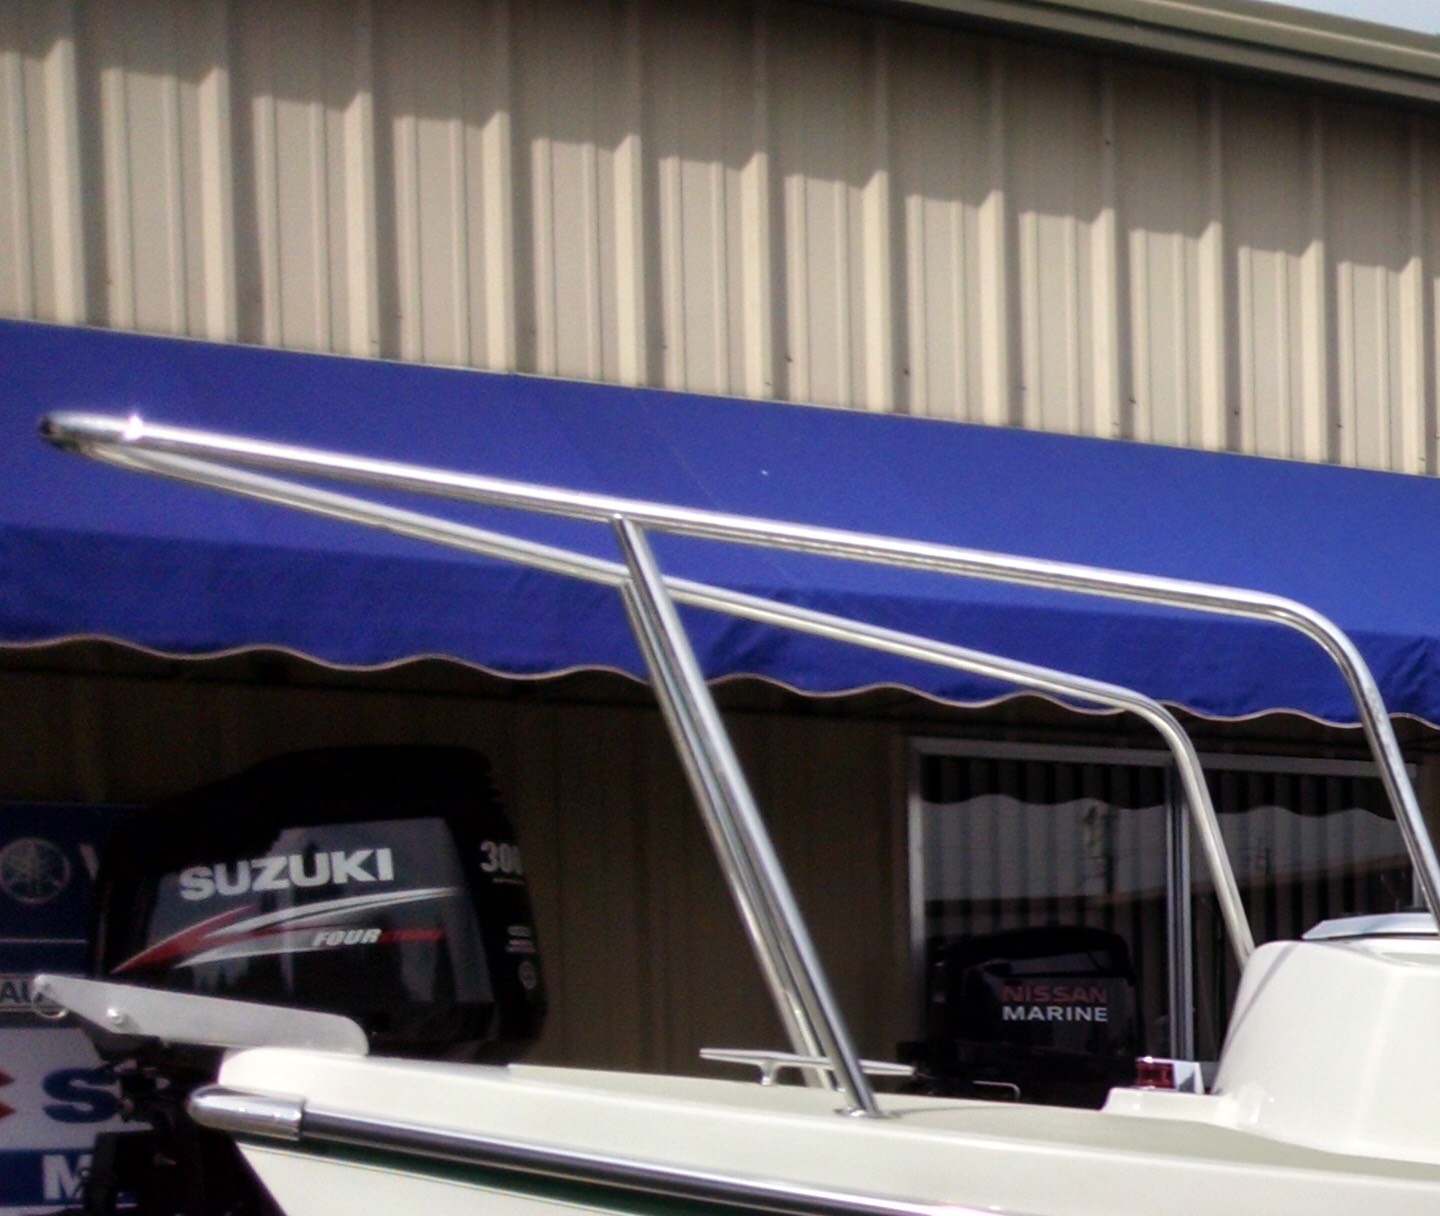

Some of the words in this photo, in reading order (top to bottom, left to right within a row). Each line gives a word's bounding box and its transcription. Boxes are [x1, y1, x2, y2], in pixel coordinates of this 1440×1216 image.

[179, 847, 395, 902] SUZUKI
[311, 927, 383, 948] FOUR
[1001, 984, 1108, 1003] NISSAN
[1001, 1005, 1109, 1022] MARINE
